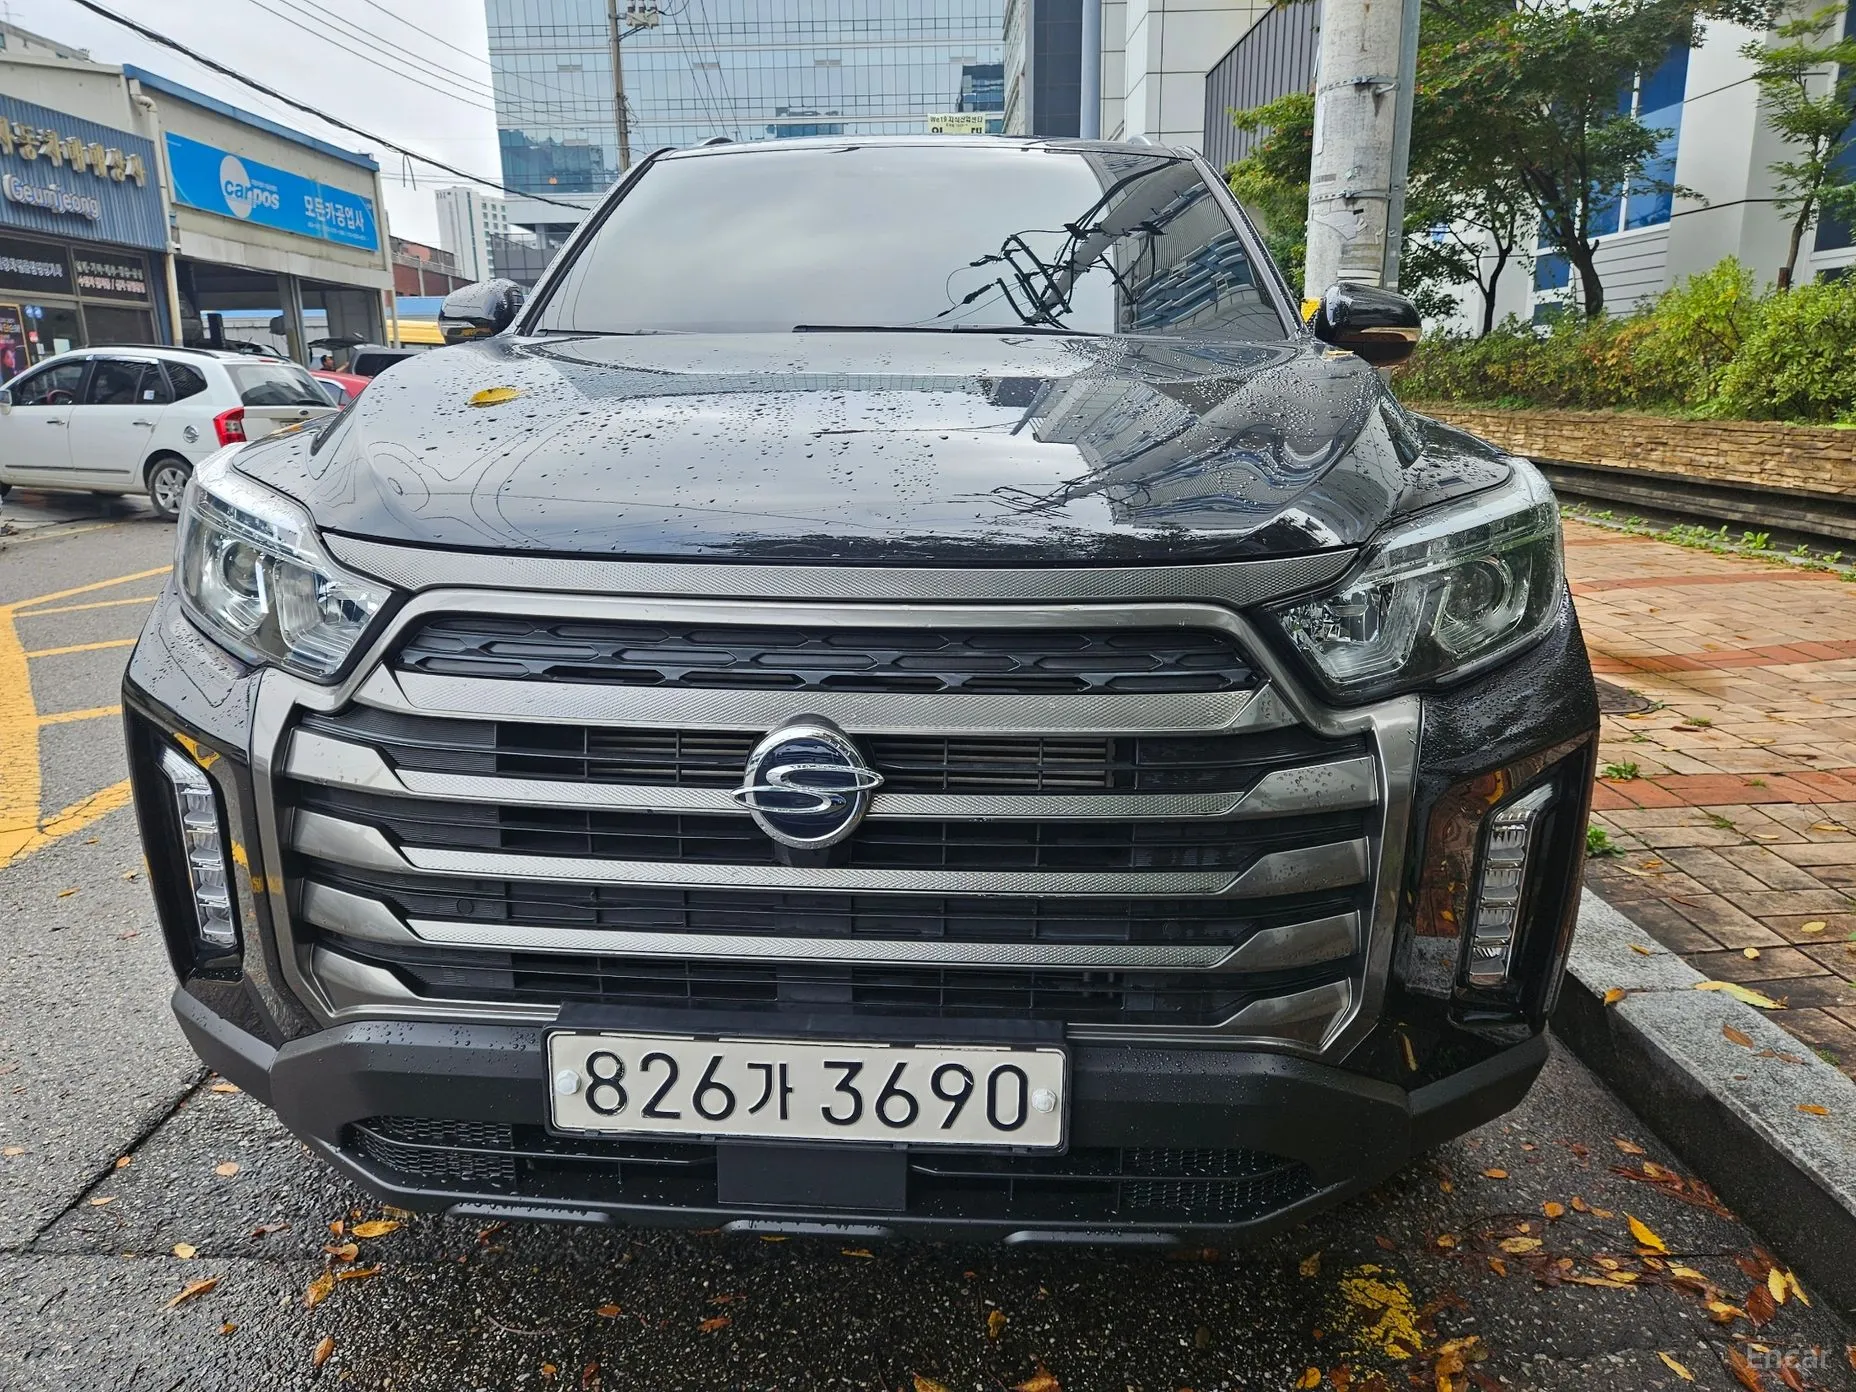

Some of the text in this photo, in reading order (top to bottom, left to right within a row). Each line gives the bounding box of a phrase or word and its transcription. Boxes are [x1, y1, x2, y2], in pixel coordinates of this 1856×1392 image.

[2, 174, 101, 220] Geumjeong
[224, 179, 280, 210] carpos
[303, 195, 365, 233] 모든카공업사
[585, 1049, 1030, 1132] 826가 3690
